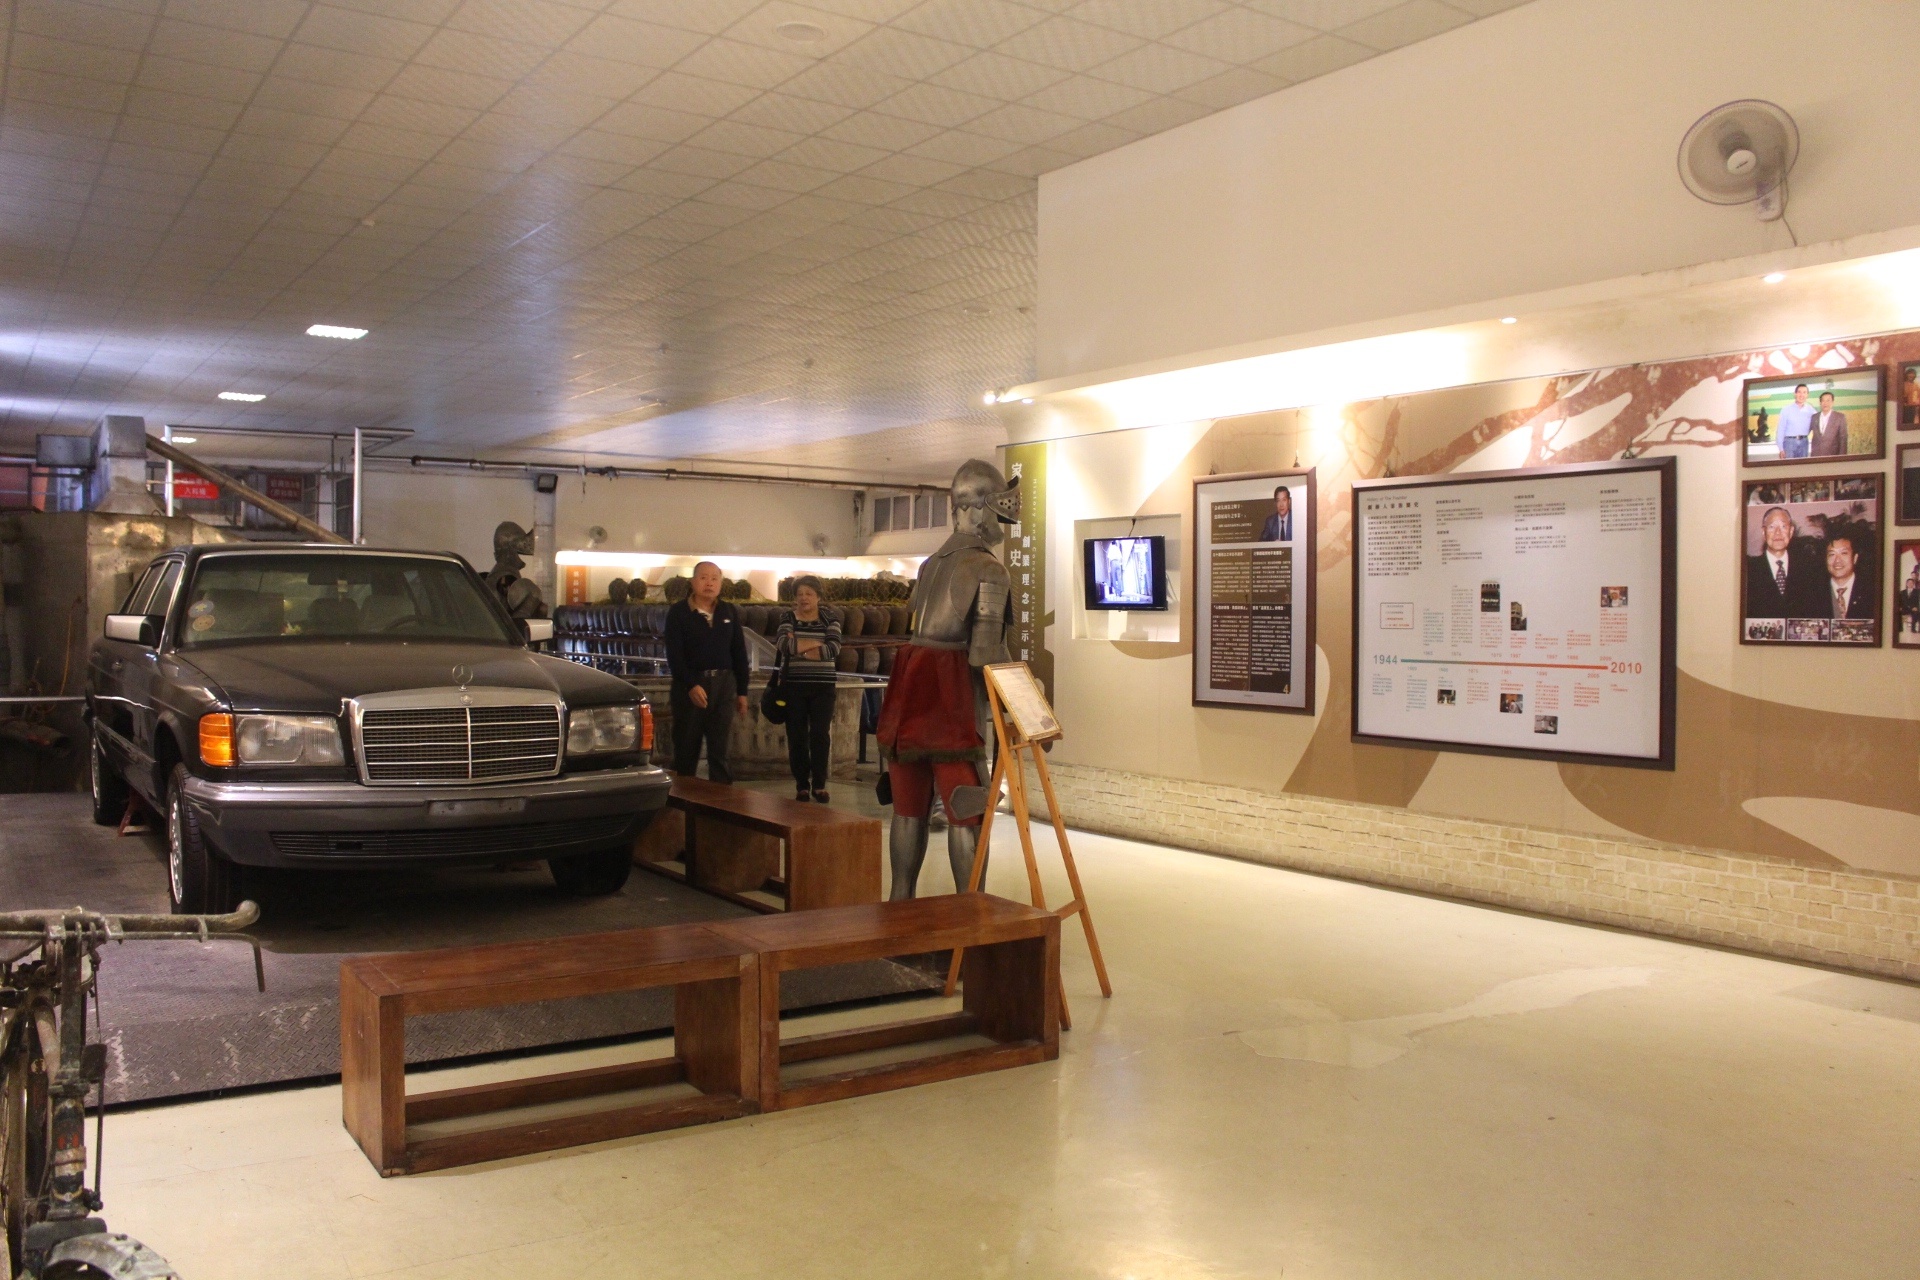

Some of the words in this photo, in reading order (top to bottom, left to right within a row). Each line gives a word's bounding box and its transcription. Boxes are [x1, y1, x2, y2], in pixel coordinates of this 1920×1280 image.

[1010, 462, 1022, 567] 家簡史
[1021, 535, 1031, 661] 創業理念展示區
[1373, 654, 1398, 665] 1944
[1610, 661, 1642, 674] 2010
